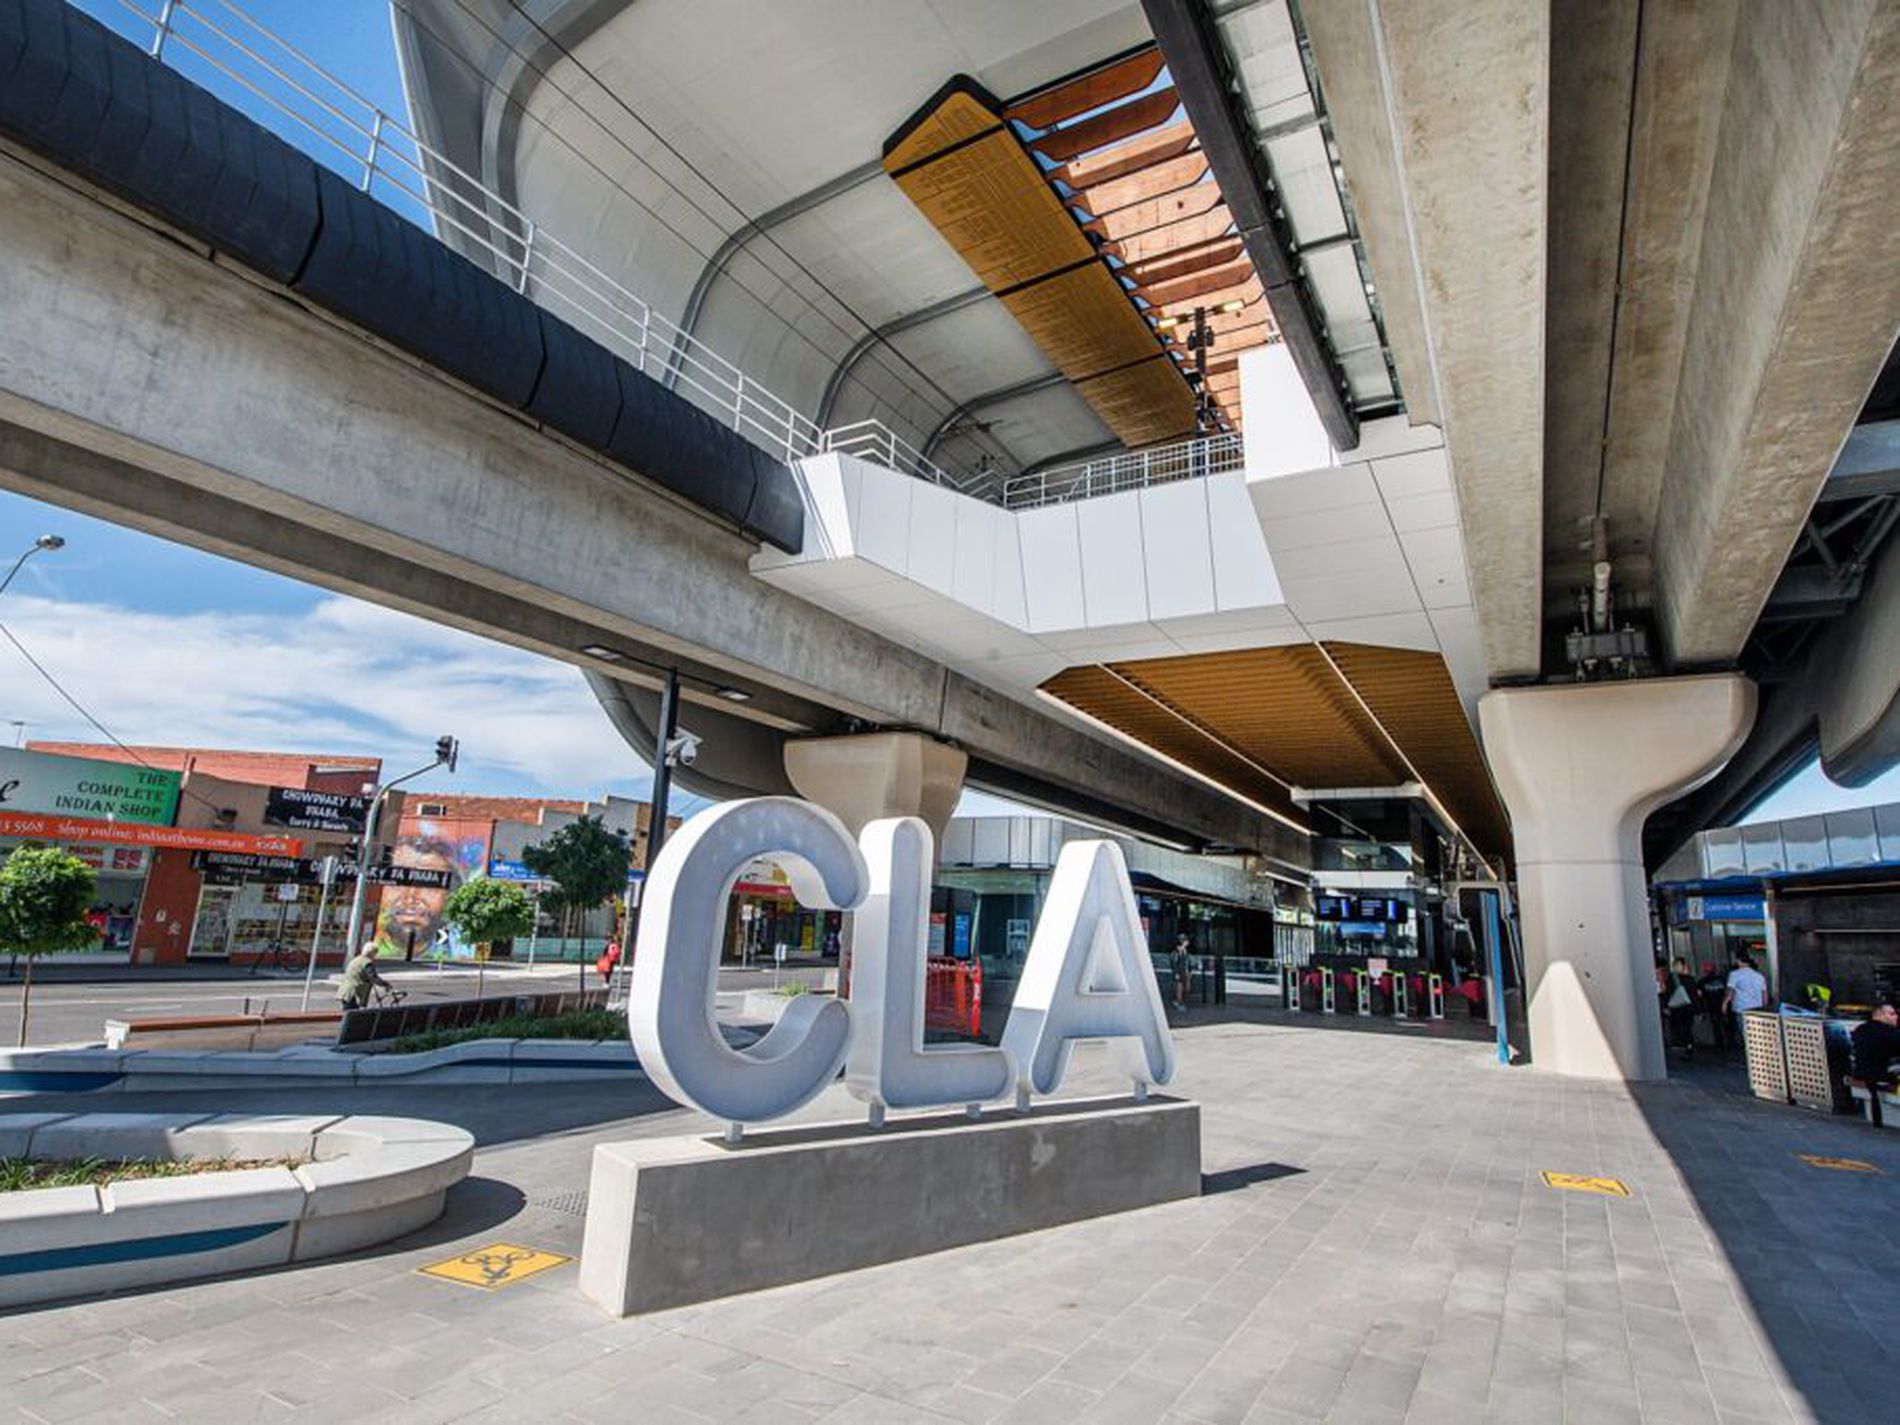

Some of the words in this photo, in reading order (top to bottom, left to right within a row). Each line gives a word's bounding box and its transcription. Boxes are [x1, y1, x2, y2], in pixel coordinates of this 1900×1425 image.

[137, 772, 168, 787] THE
[78, 780, 164, 803] COMPLETE
[56, 795, 115, 812] INDIAN
[119, 804, 161, 819] SHOP
[629, 796, 1176, 1122] CLA
